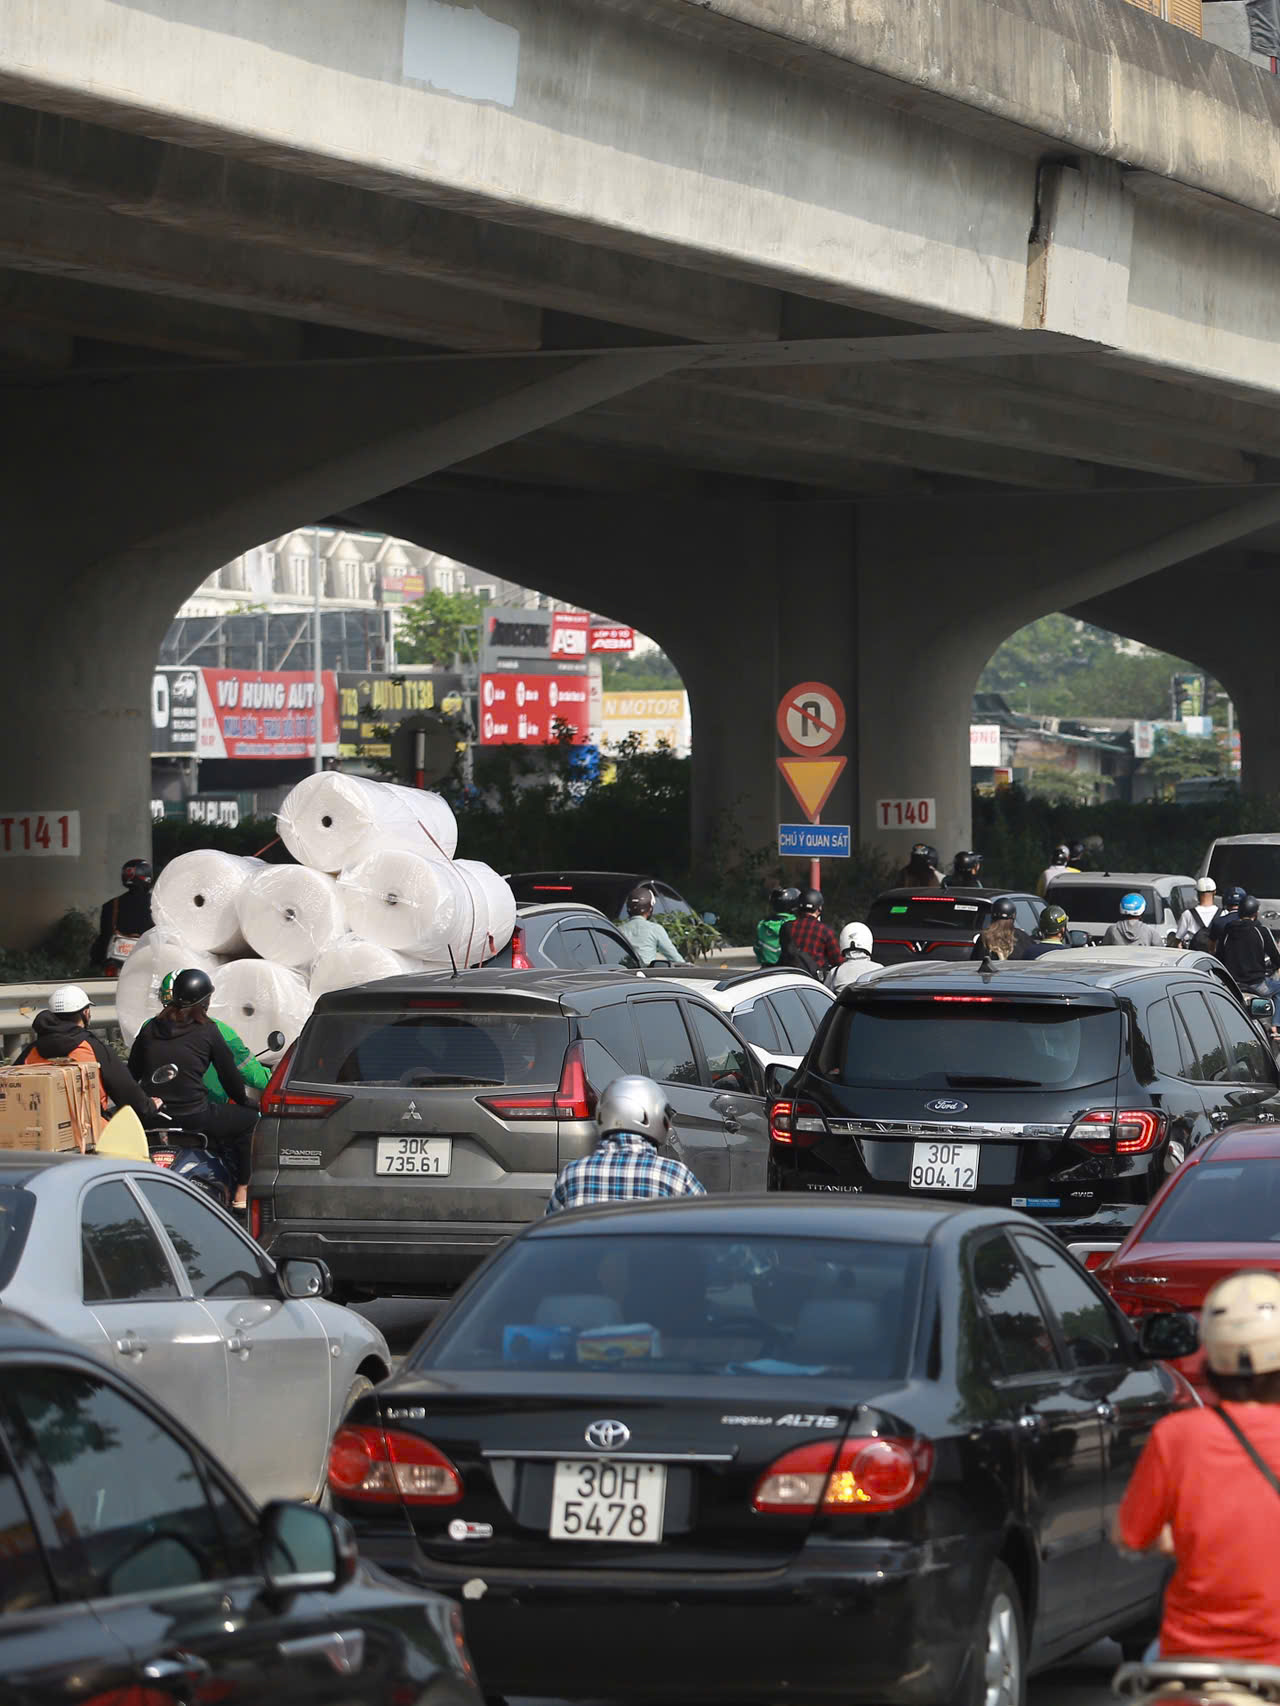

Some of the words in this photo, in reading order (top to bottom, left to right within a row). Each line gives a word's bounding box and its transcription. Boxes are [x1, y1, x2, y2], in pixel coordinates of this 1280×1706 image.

[592, 638, 633, 649] ABM
[619, 698, 681, 715] MOTOR
[881, 800, 929, 826] T140
[0, 815, 70, 851] T141
[780, 831, 797, 847] CHÚ
[798, 831, 805, 846] Ý
[806, 833, 829, 848] QUAN
[831, 832, 849, 848] SÁT
[934, 1100, 958, 1111] Ford
[398, 1138, 430, 1155] 30K
[928, 1145, 963, 1165] 30F
[385, 1156, 441, 1173] 735.61
[912, 1165, 975, 1189] 904.12
[806, 1183, 863, 1194] TITANIUM
[721, 1415, 773, 1427] COROLLA
[775, 1414, 840, 1428] ALTIS
[576, 1465, 641, 1500] 30H
[563, 1502, 647, 1537] 5478
